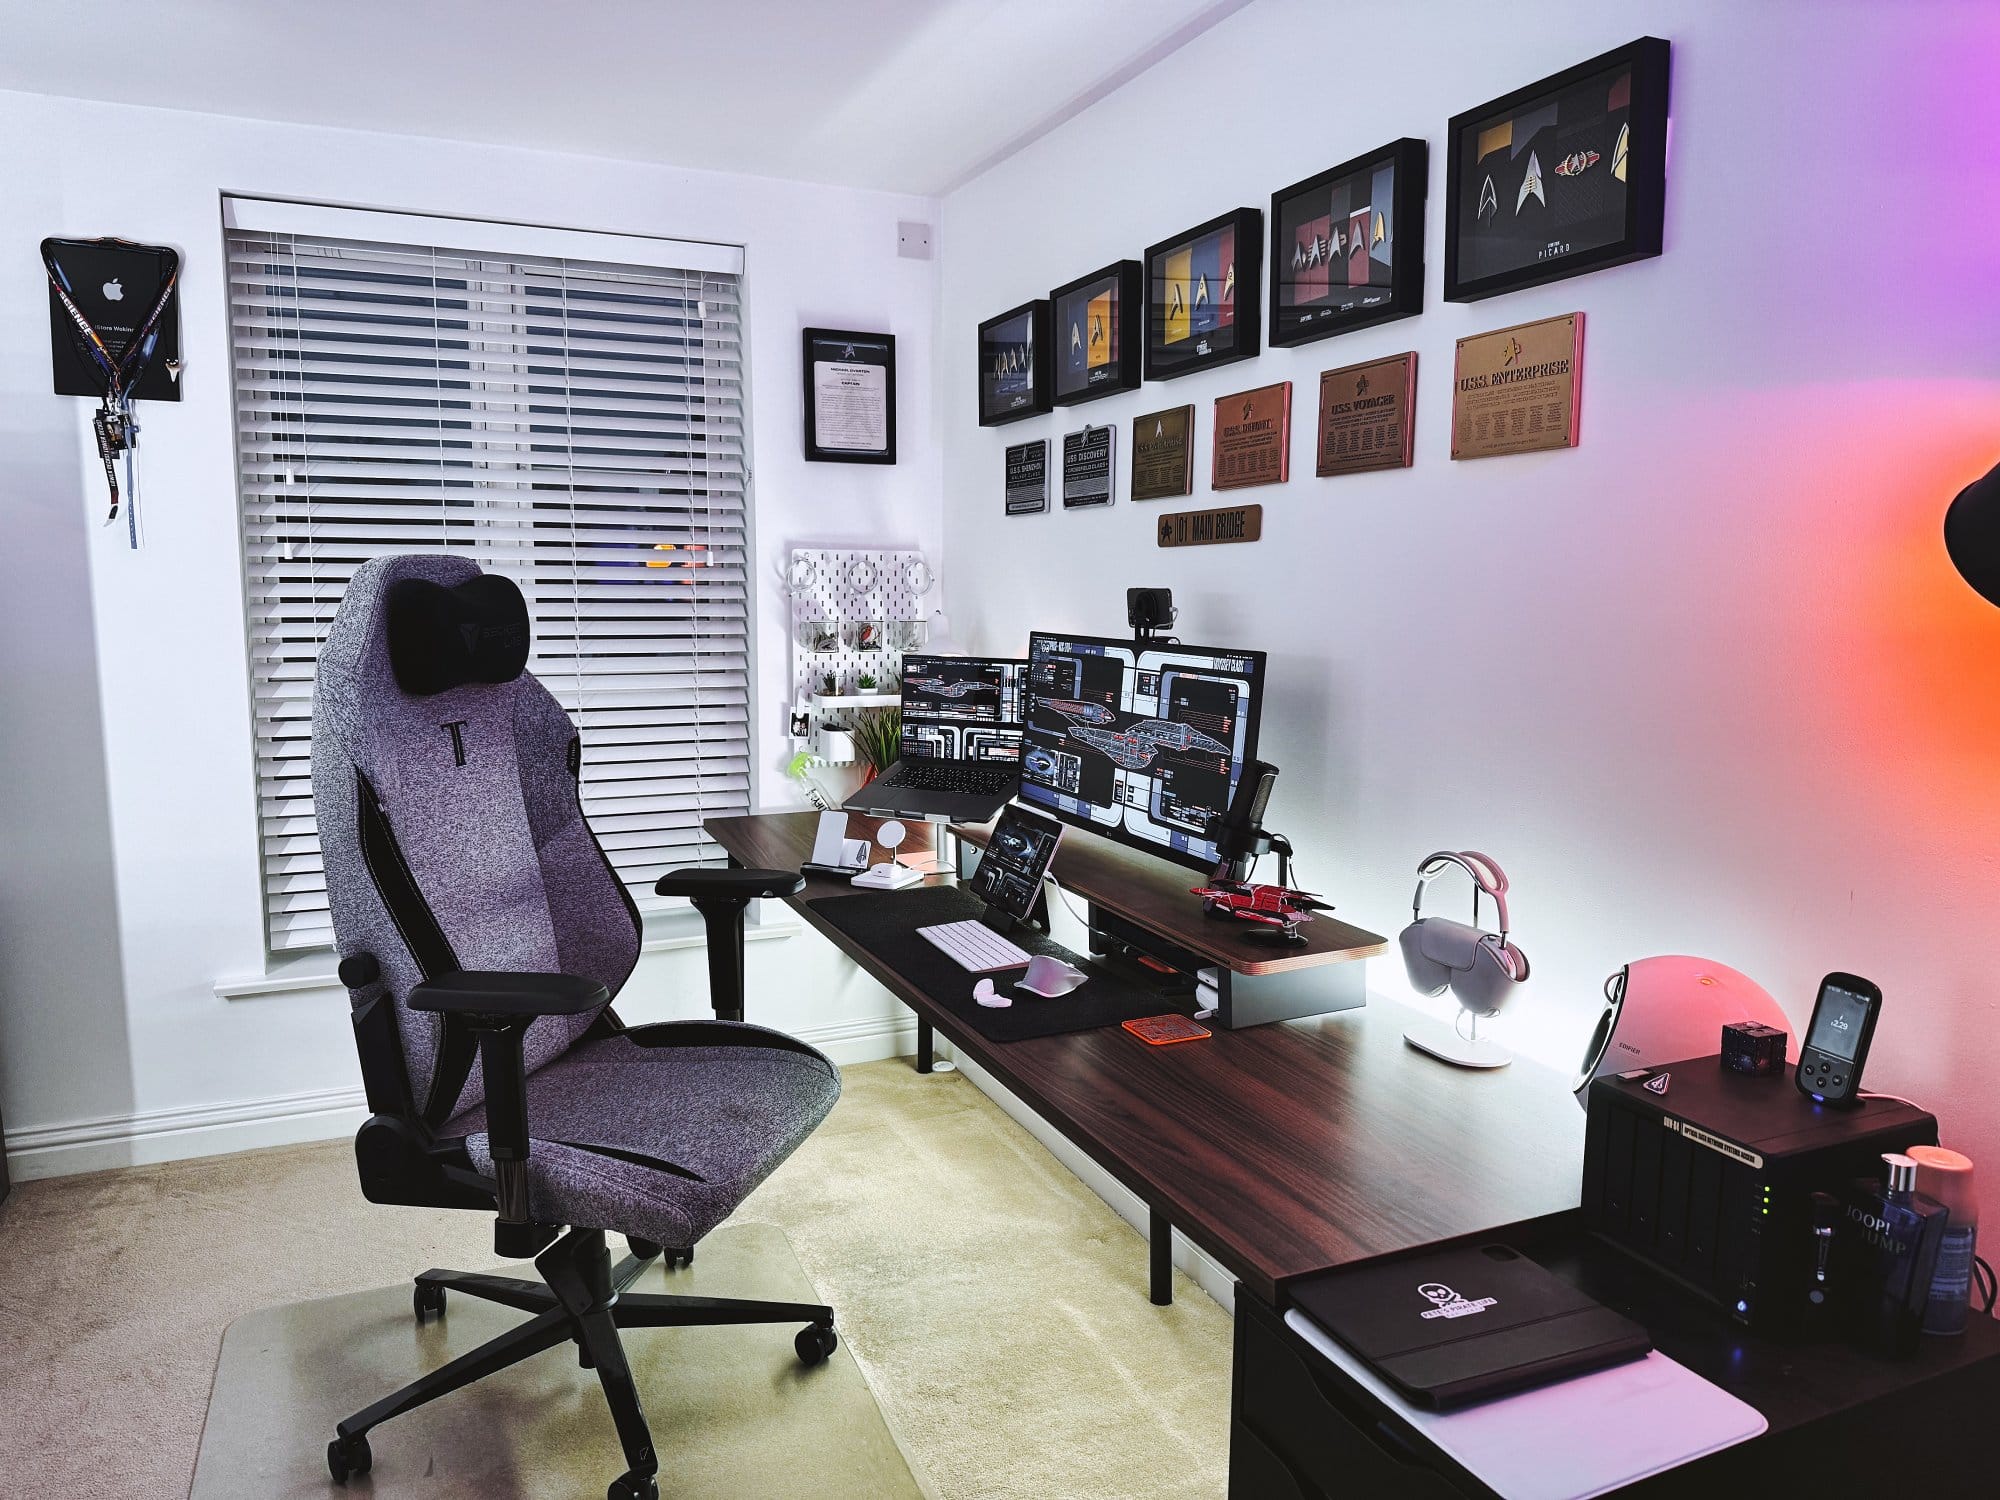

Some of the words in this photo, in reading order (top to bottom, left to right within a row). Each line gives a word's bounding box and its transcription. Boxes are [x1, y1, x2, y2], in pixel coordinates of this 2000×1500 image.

[1538, 243, 1570, 260] PICARD
[59, 289, 93, 336] SCIENCE
[1490, 359, 1569, 386] ENTERPRISE
[1352, 394, 1396, 411] VOYAGER
[1078, 448, 1107, 462] DISCOVERY
[1178, 517, 1188, 542] 01
[1192, 514, 1213, 541] MAIN
[1215, 510, 1246, 540] BRIDGE
[1618, 1042, 1641, 1055] EDIFIER
[1846, 1203, 1892, 1237] JOOP!
